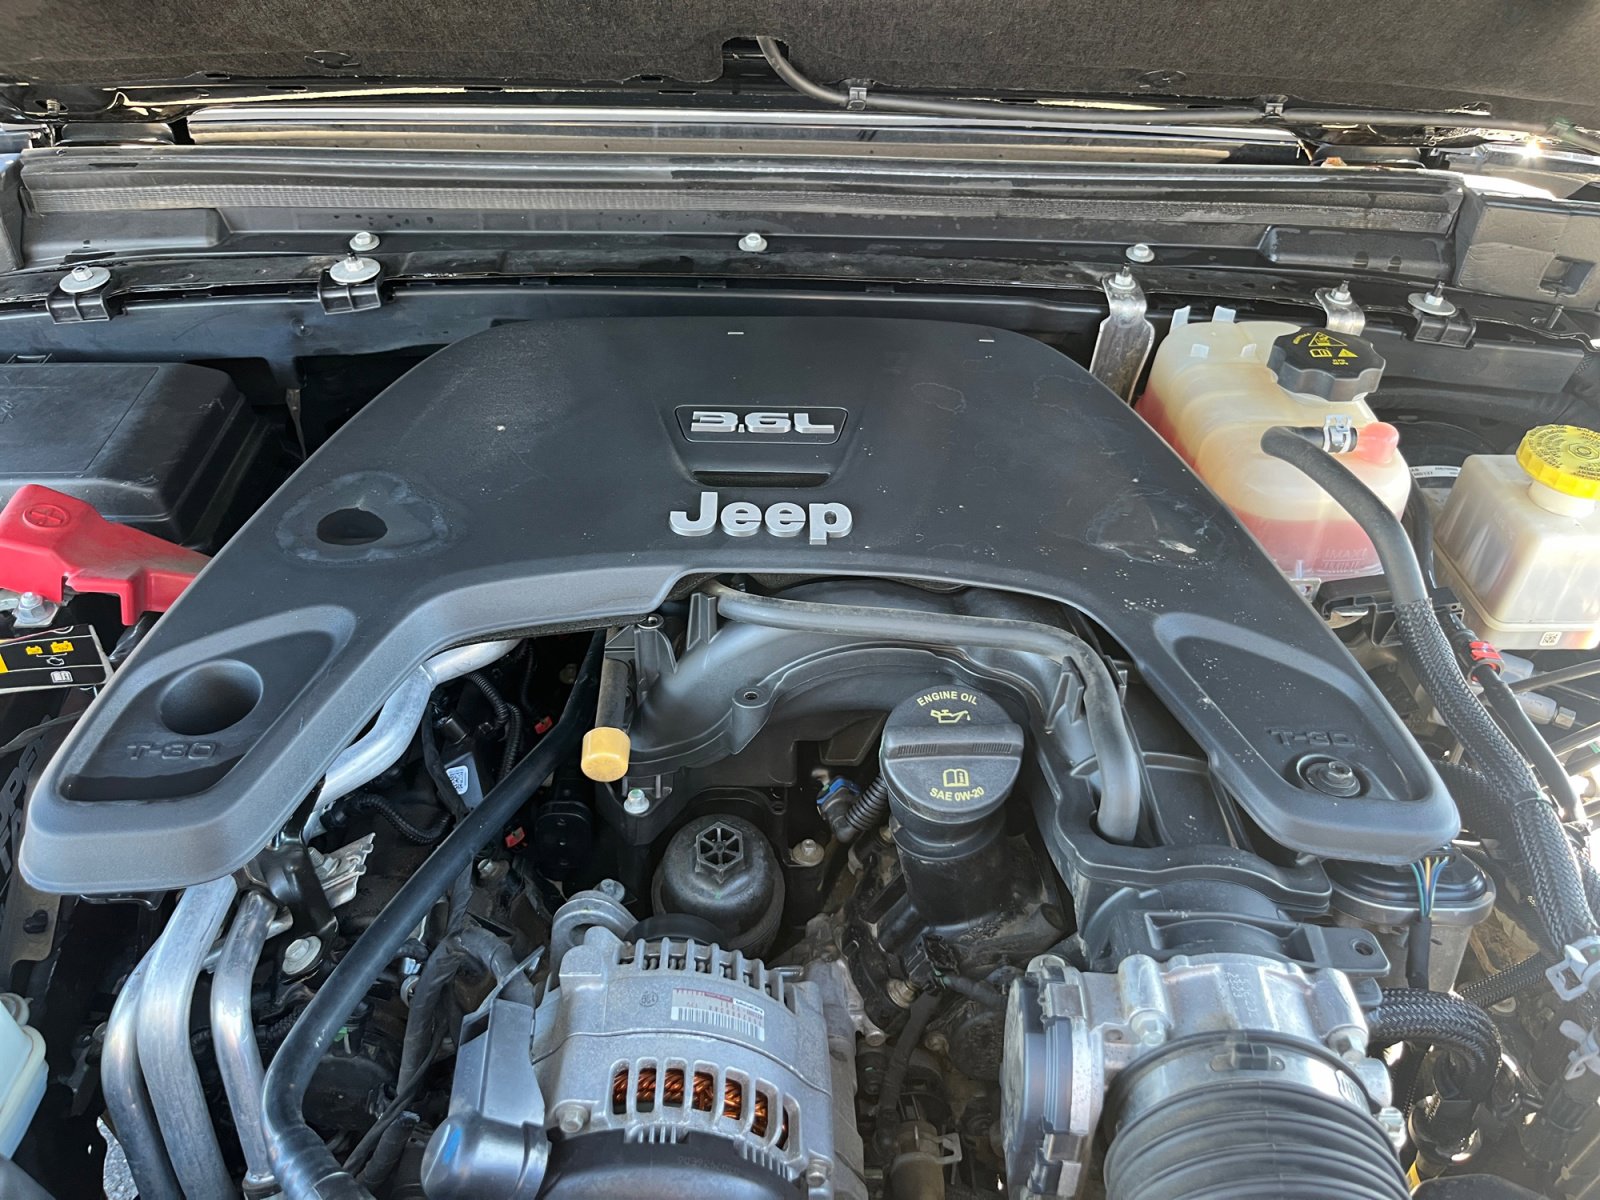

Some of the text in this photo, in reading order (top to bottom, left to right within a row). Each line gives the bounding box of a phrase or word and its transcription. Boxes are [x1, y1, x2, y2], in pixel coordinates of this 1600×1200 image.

[691, 411, 835, 434] 3.6L
[669, 491, 853, 545] Jeep
[916, 690, 978, 707] ENGINE OIL
[929, 786, 985, 802] SAE 0W-20
